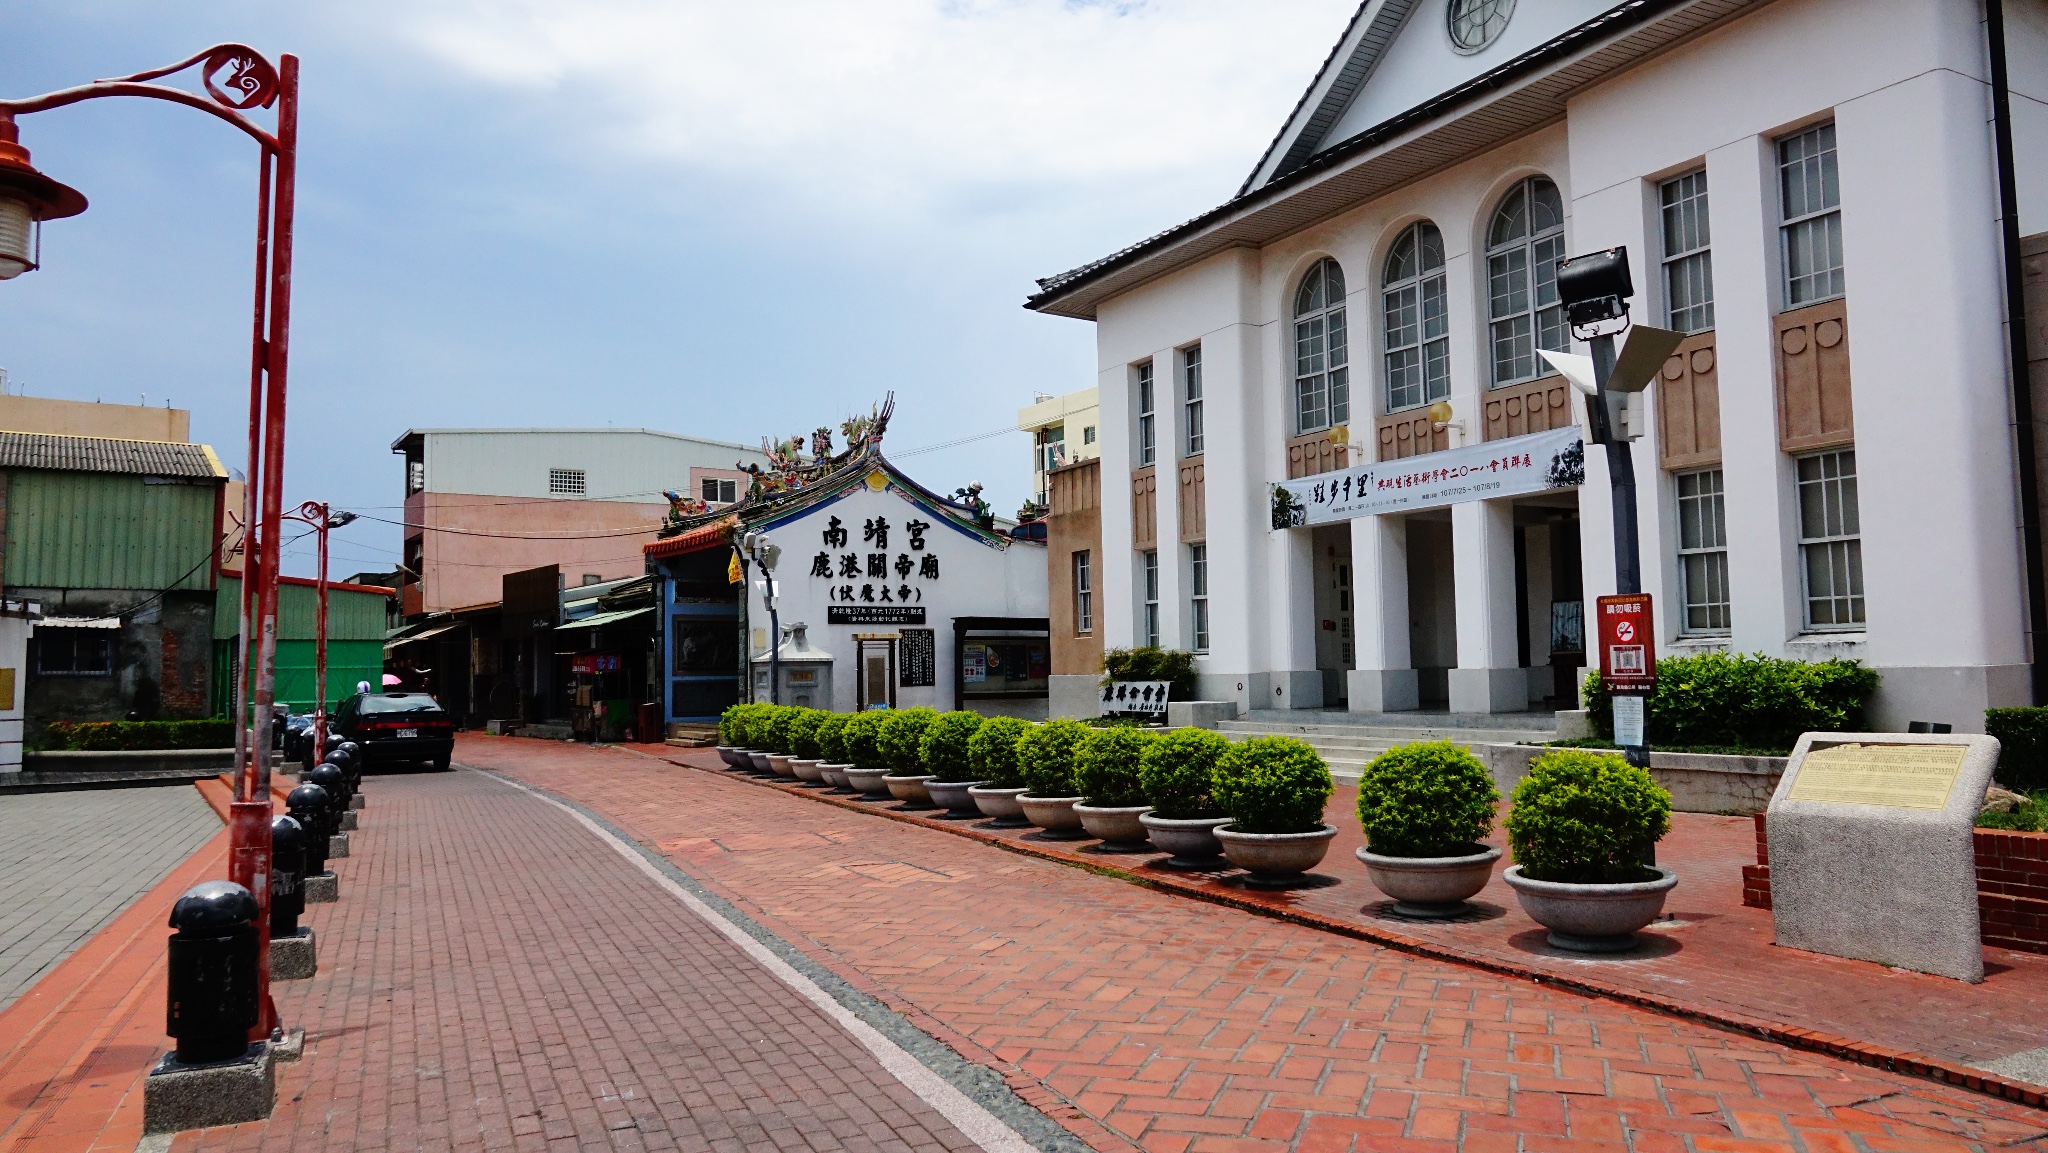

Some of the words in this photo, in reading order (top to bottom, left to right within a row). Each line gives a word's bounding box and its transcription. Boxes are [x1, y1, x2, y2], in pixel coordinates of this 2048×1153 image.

[1440, 487, 1467, 497] 107/7/25
[1472, 481, 1501, 492] 107/8/19
[822, 515, 931, 551] 南靖宮
[809, 551, 940, 580] 鹿港關帝廟
[829, 583, 922, 603] (伏魔大帝)
